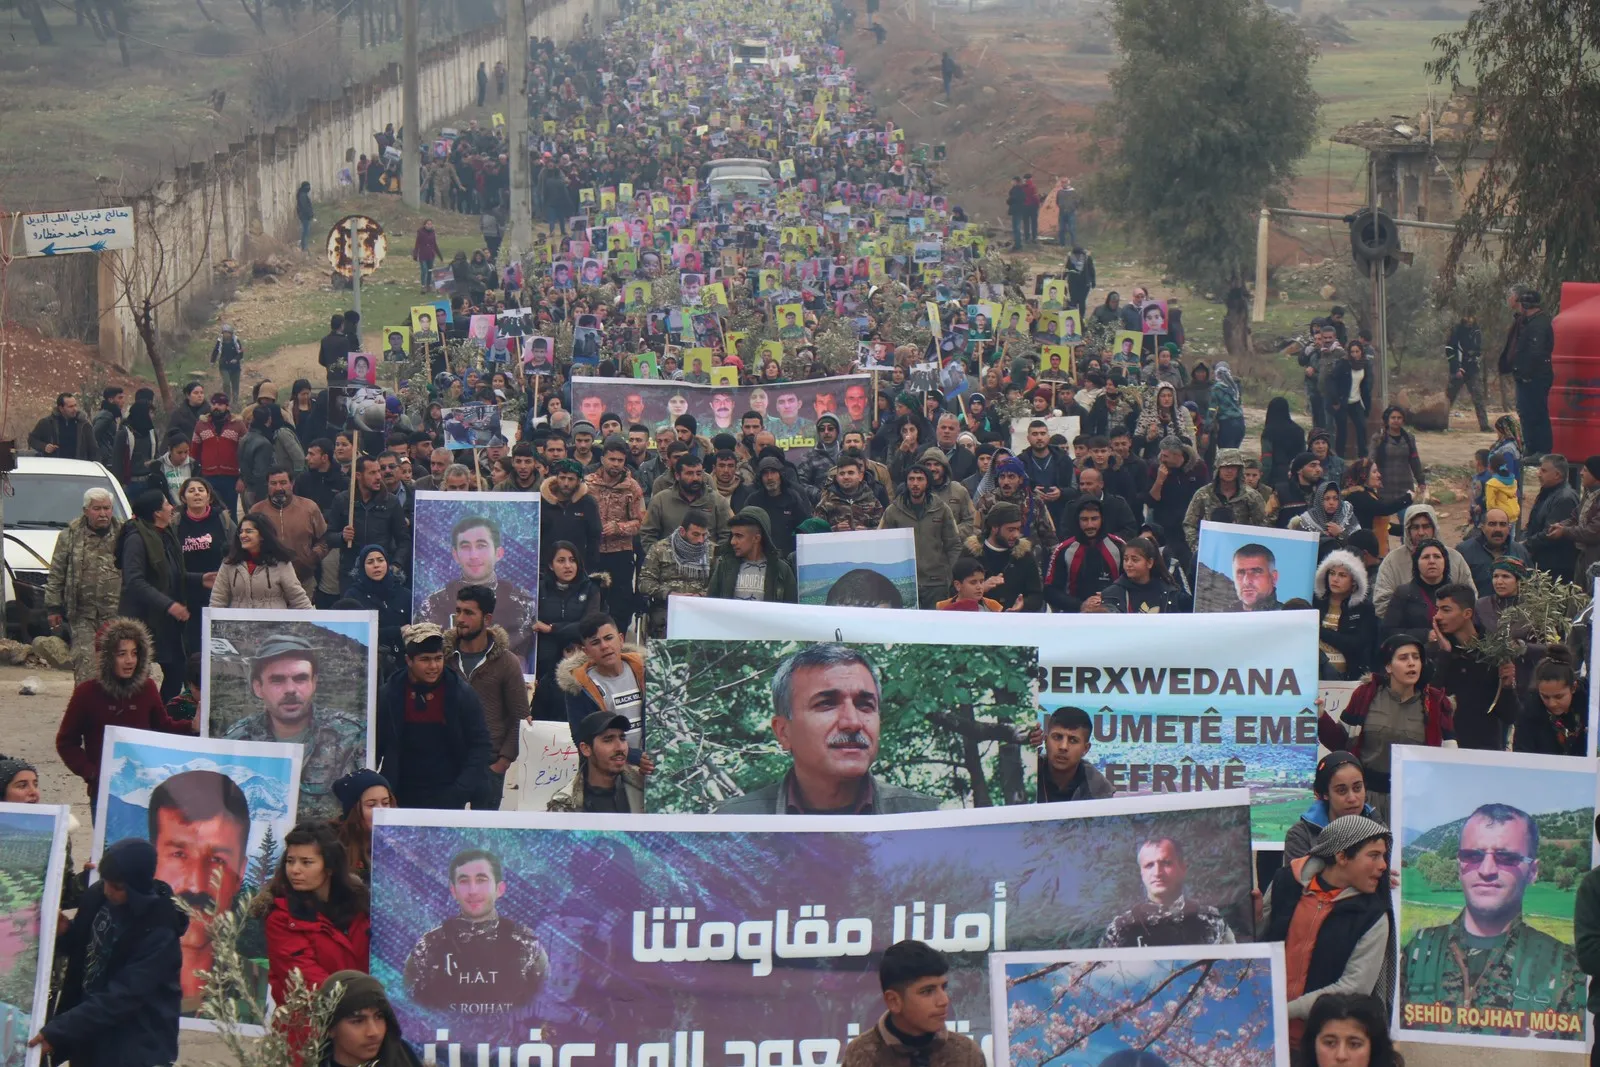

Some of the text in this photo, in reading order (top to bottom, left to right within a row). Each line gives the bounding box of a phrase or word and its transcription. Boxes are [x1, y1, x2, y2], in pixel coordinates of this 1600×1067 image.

[26, 209, 129, 227] معالج فيزيائي الطب البديل
[66, 226, 88, 239] أحمد
[91, 227, 116, 236] محمد
[775, 435, 815, 451] مقاو
[182, 541, 210, 553] PANTHER
[615, 695, 633, 705] BLACK
[1094, 705, 1222, 744] ÛMETÊ
[1235, 707, 1318, 744] EMÊ
[541, 734, 578, 760] هداء
[1105, 755, 1247, 793] EFRÎNÊ
[632, 881, 1008, 977] أملنا مقاومتنا
[460, 1003, 513, 1014] ROJHAT
[1404, 1001, 1582, 1033] ŞEHÎD ROJHAT MÛSA
